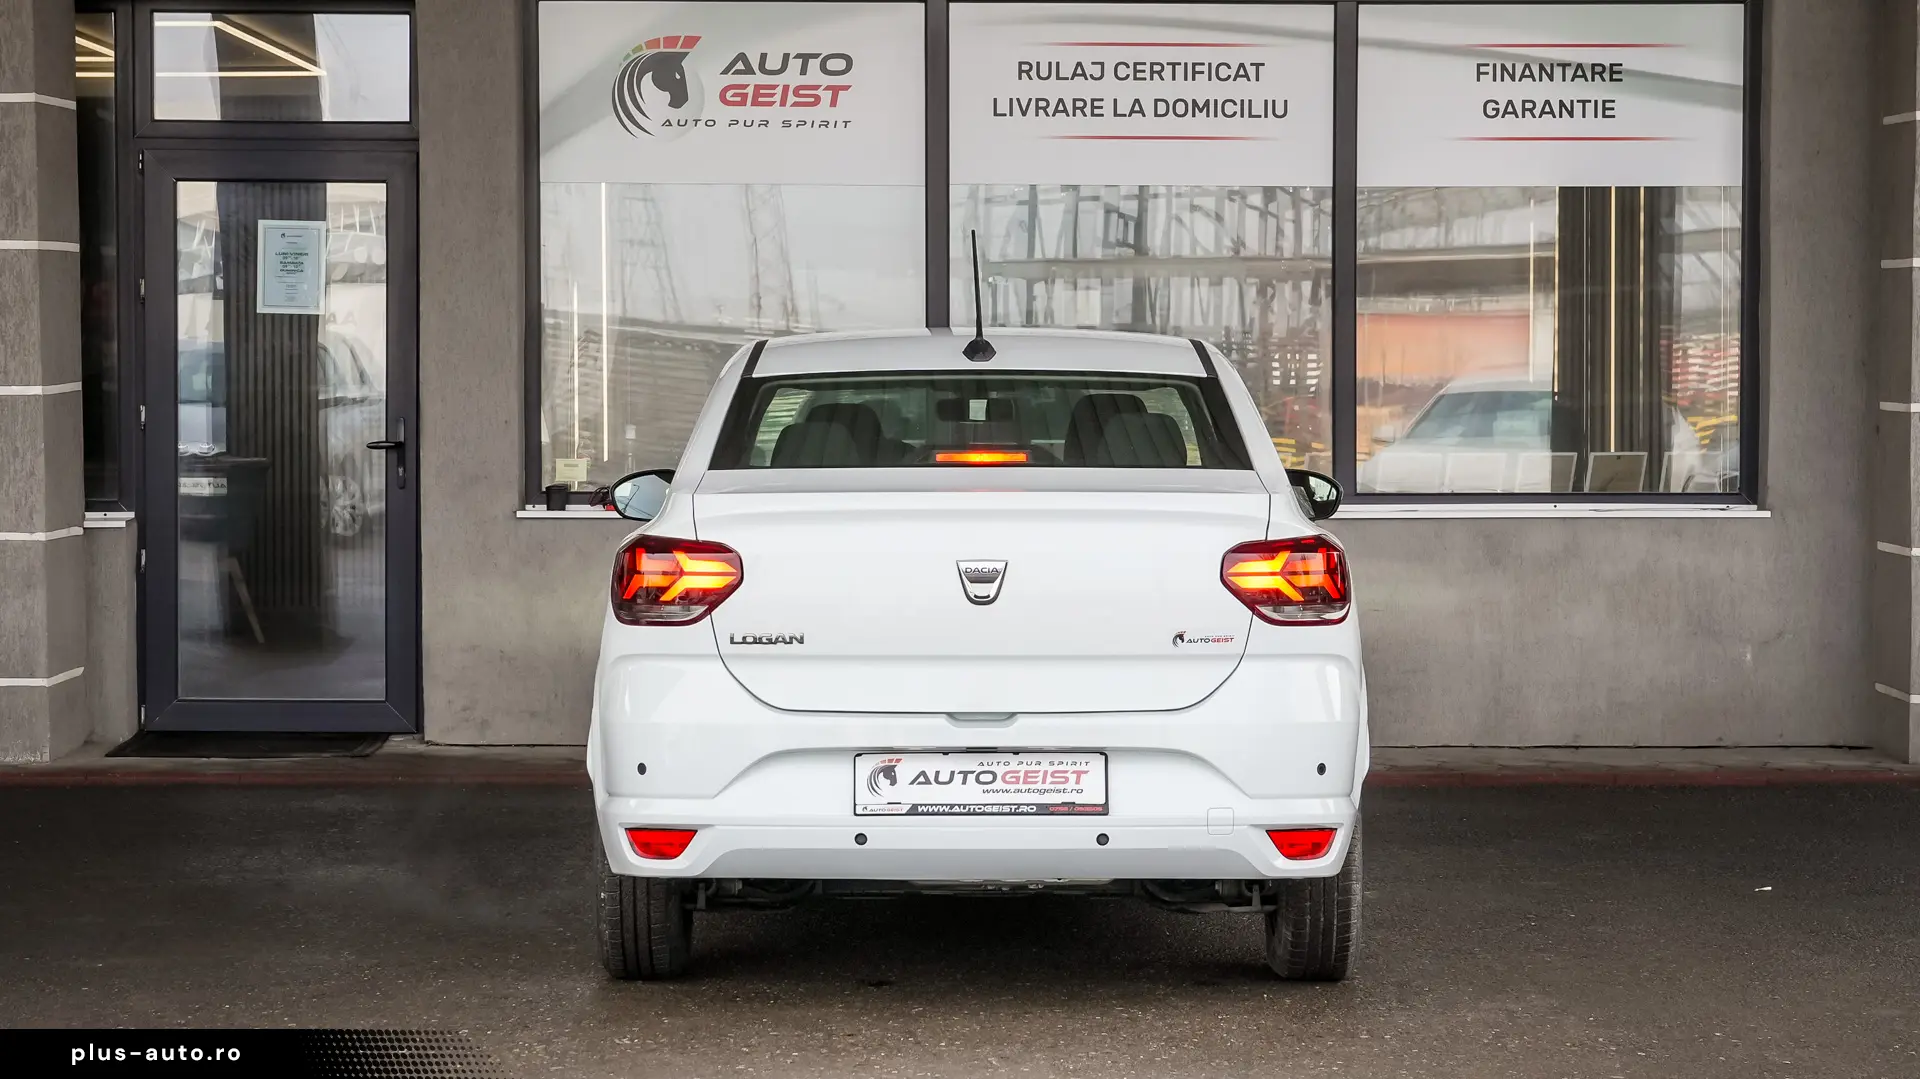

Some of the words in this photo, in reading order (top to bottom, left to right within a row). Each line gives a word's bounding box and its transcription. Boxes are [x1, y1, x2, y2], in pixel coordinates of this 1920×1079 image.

[719, 52, 854, 76] AUTO
[1017, 61, 1105, 81] RULAJ
[1113, 62, 1266, 82] CERTIFICAT
[1476, 62, 1624, 82] FINANTARE
[718, 84, 853, 107] GEIST
[992, 97, 1105, 117] LIVRARE
[1113, 98, 1147, 118] LA
[1153, 99, 1289, 119] DOMICILIU
[1482, 99, 1616, 119] GARANTIE
[661, 118, 717, 128] AUTO
[728, 119, 770, 128] PUR
[781, 119, 852, 129] SPIRIT
[964, 566, 1000, 575] DACIA
[729, 632, 805, 645] LOGAN
[908, 770, 1090, 786] AUTOGEIST
[982, 787, 1084, 795] www.autogeist.ro
[917, 805, 1037, 813] WWW.AUTOGEIST.RO
